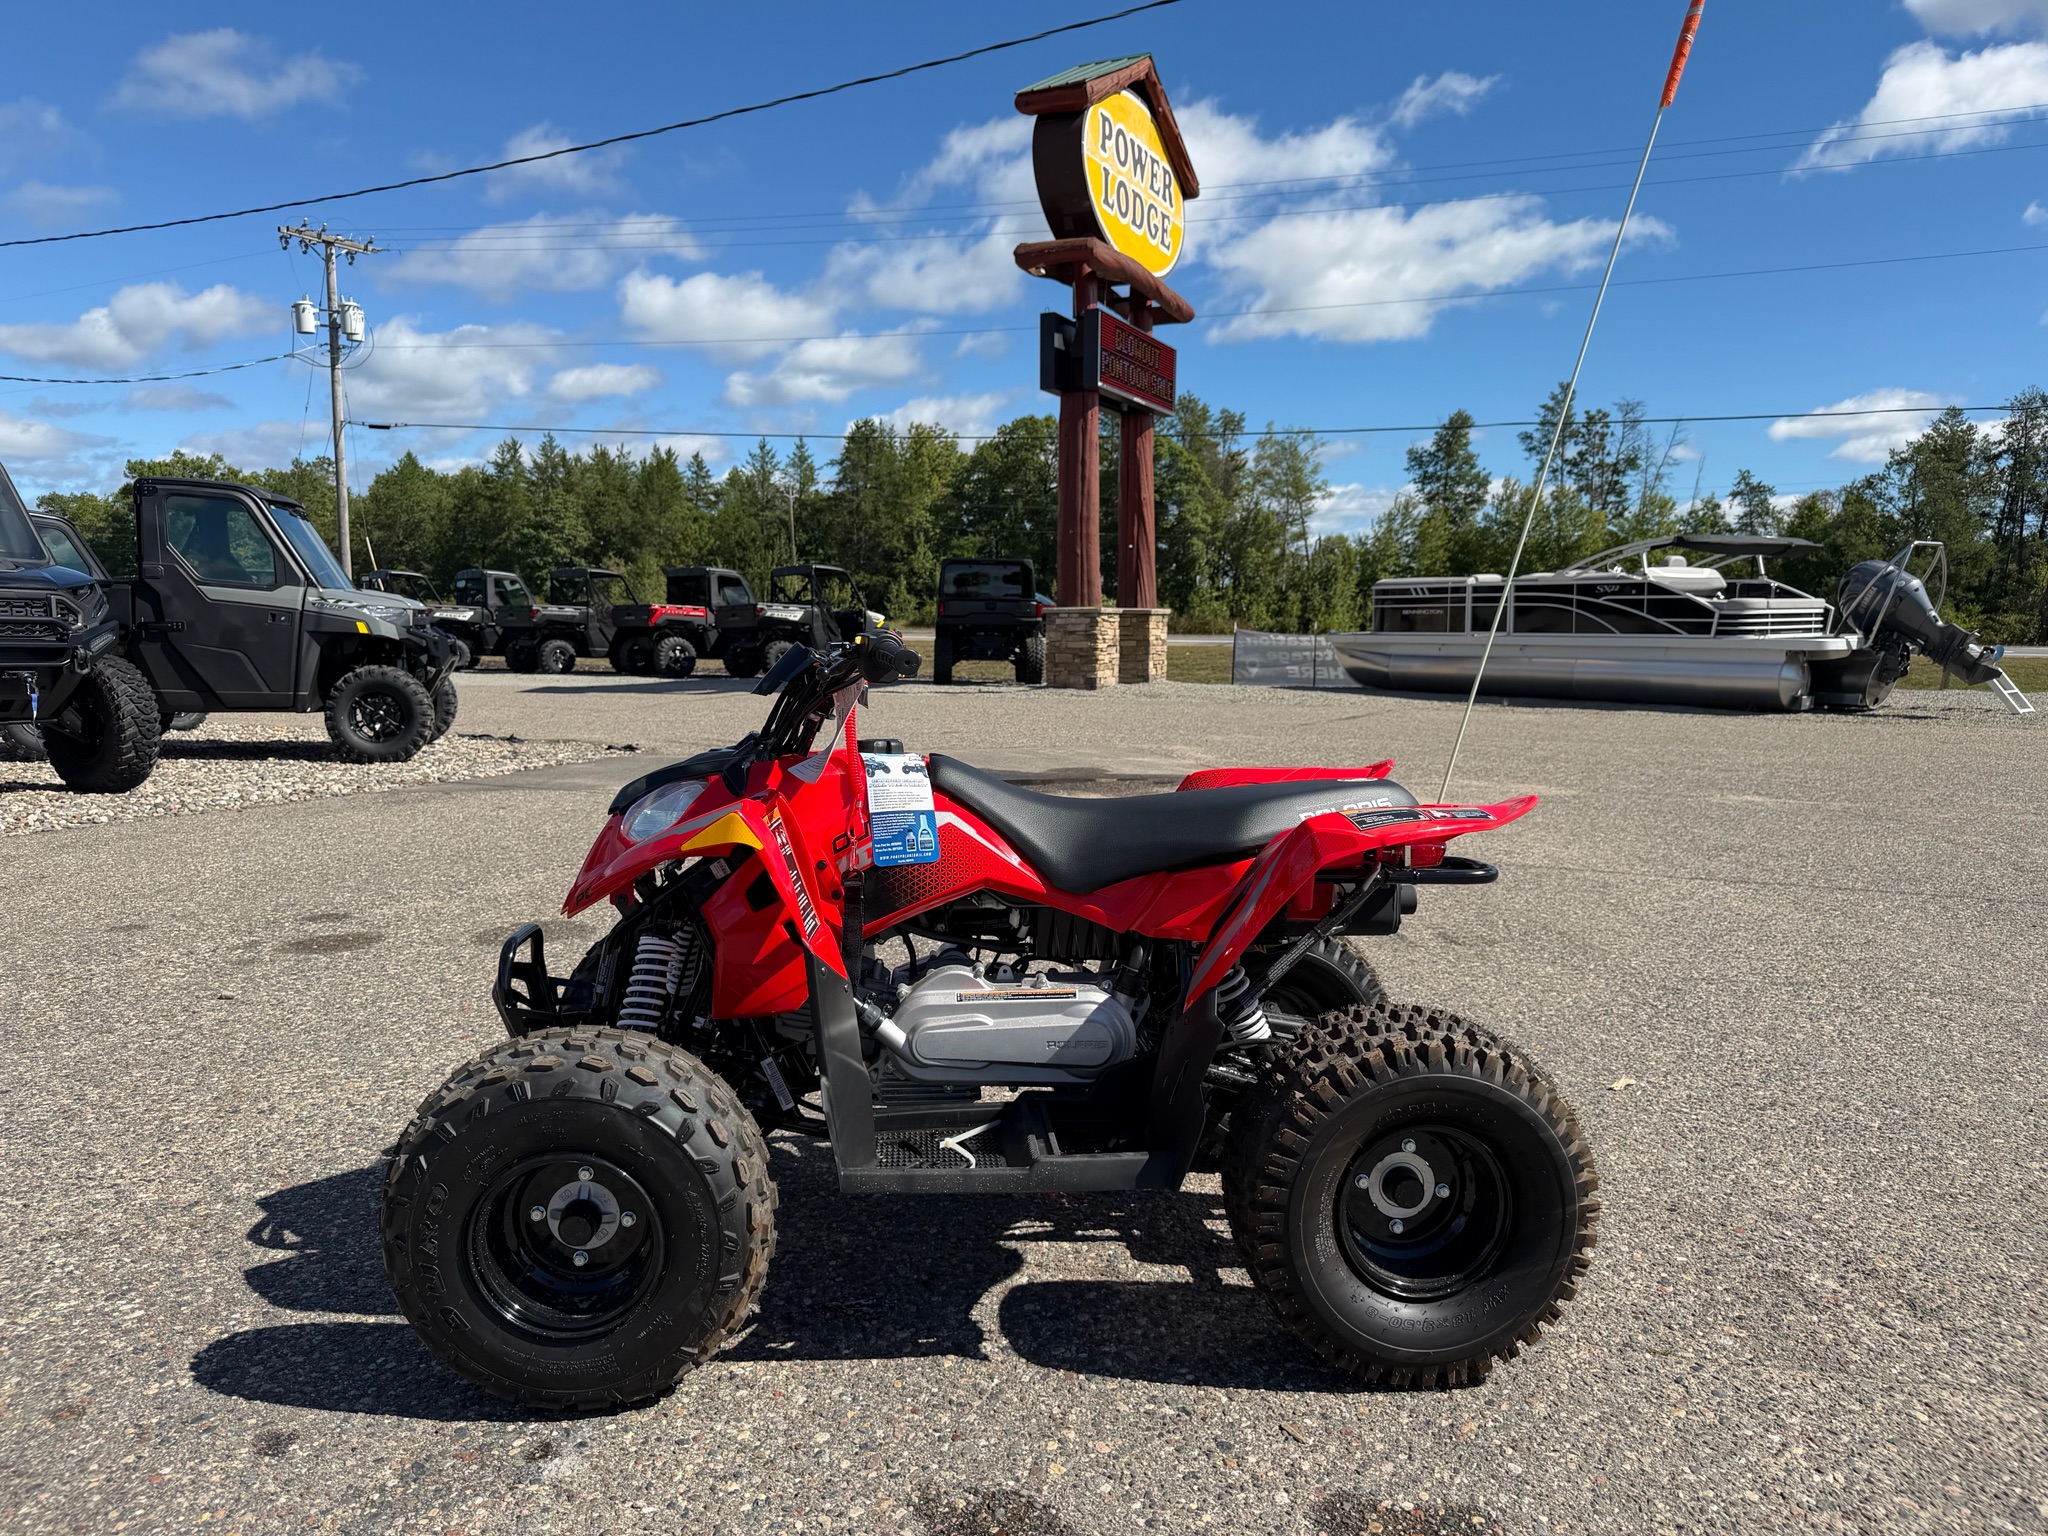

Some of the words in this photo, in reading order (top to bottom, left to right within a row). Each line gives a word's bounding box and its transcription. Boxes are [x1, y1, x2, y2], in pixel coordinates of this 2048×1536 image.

[1100, 112, 1174, 208] POWER
[1103, 167, 1171, 252] LODGE
[1102, 351, 1148, 390] PONTOON
[1860, 585, 1878, 609] YAMAHA
[1046, 1040, 1108, 1050] POLARIS
